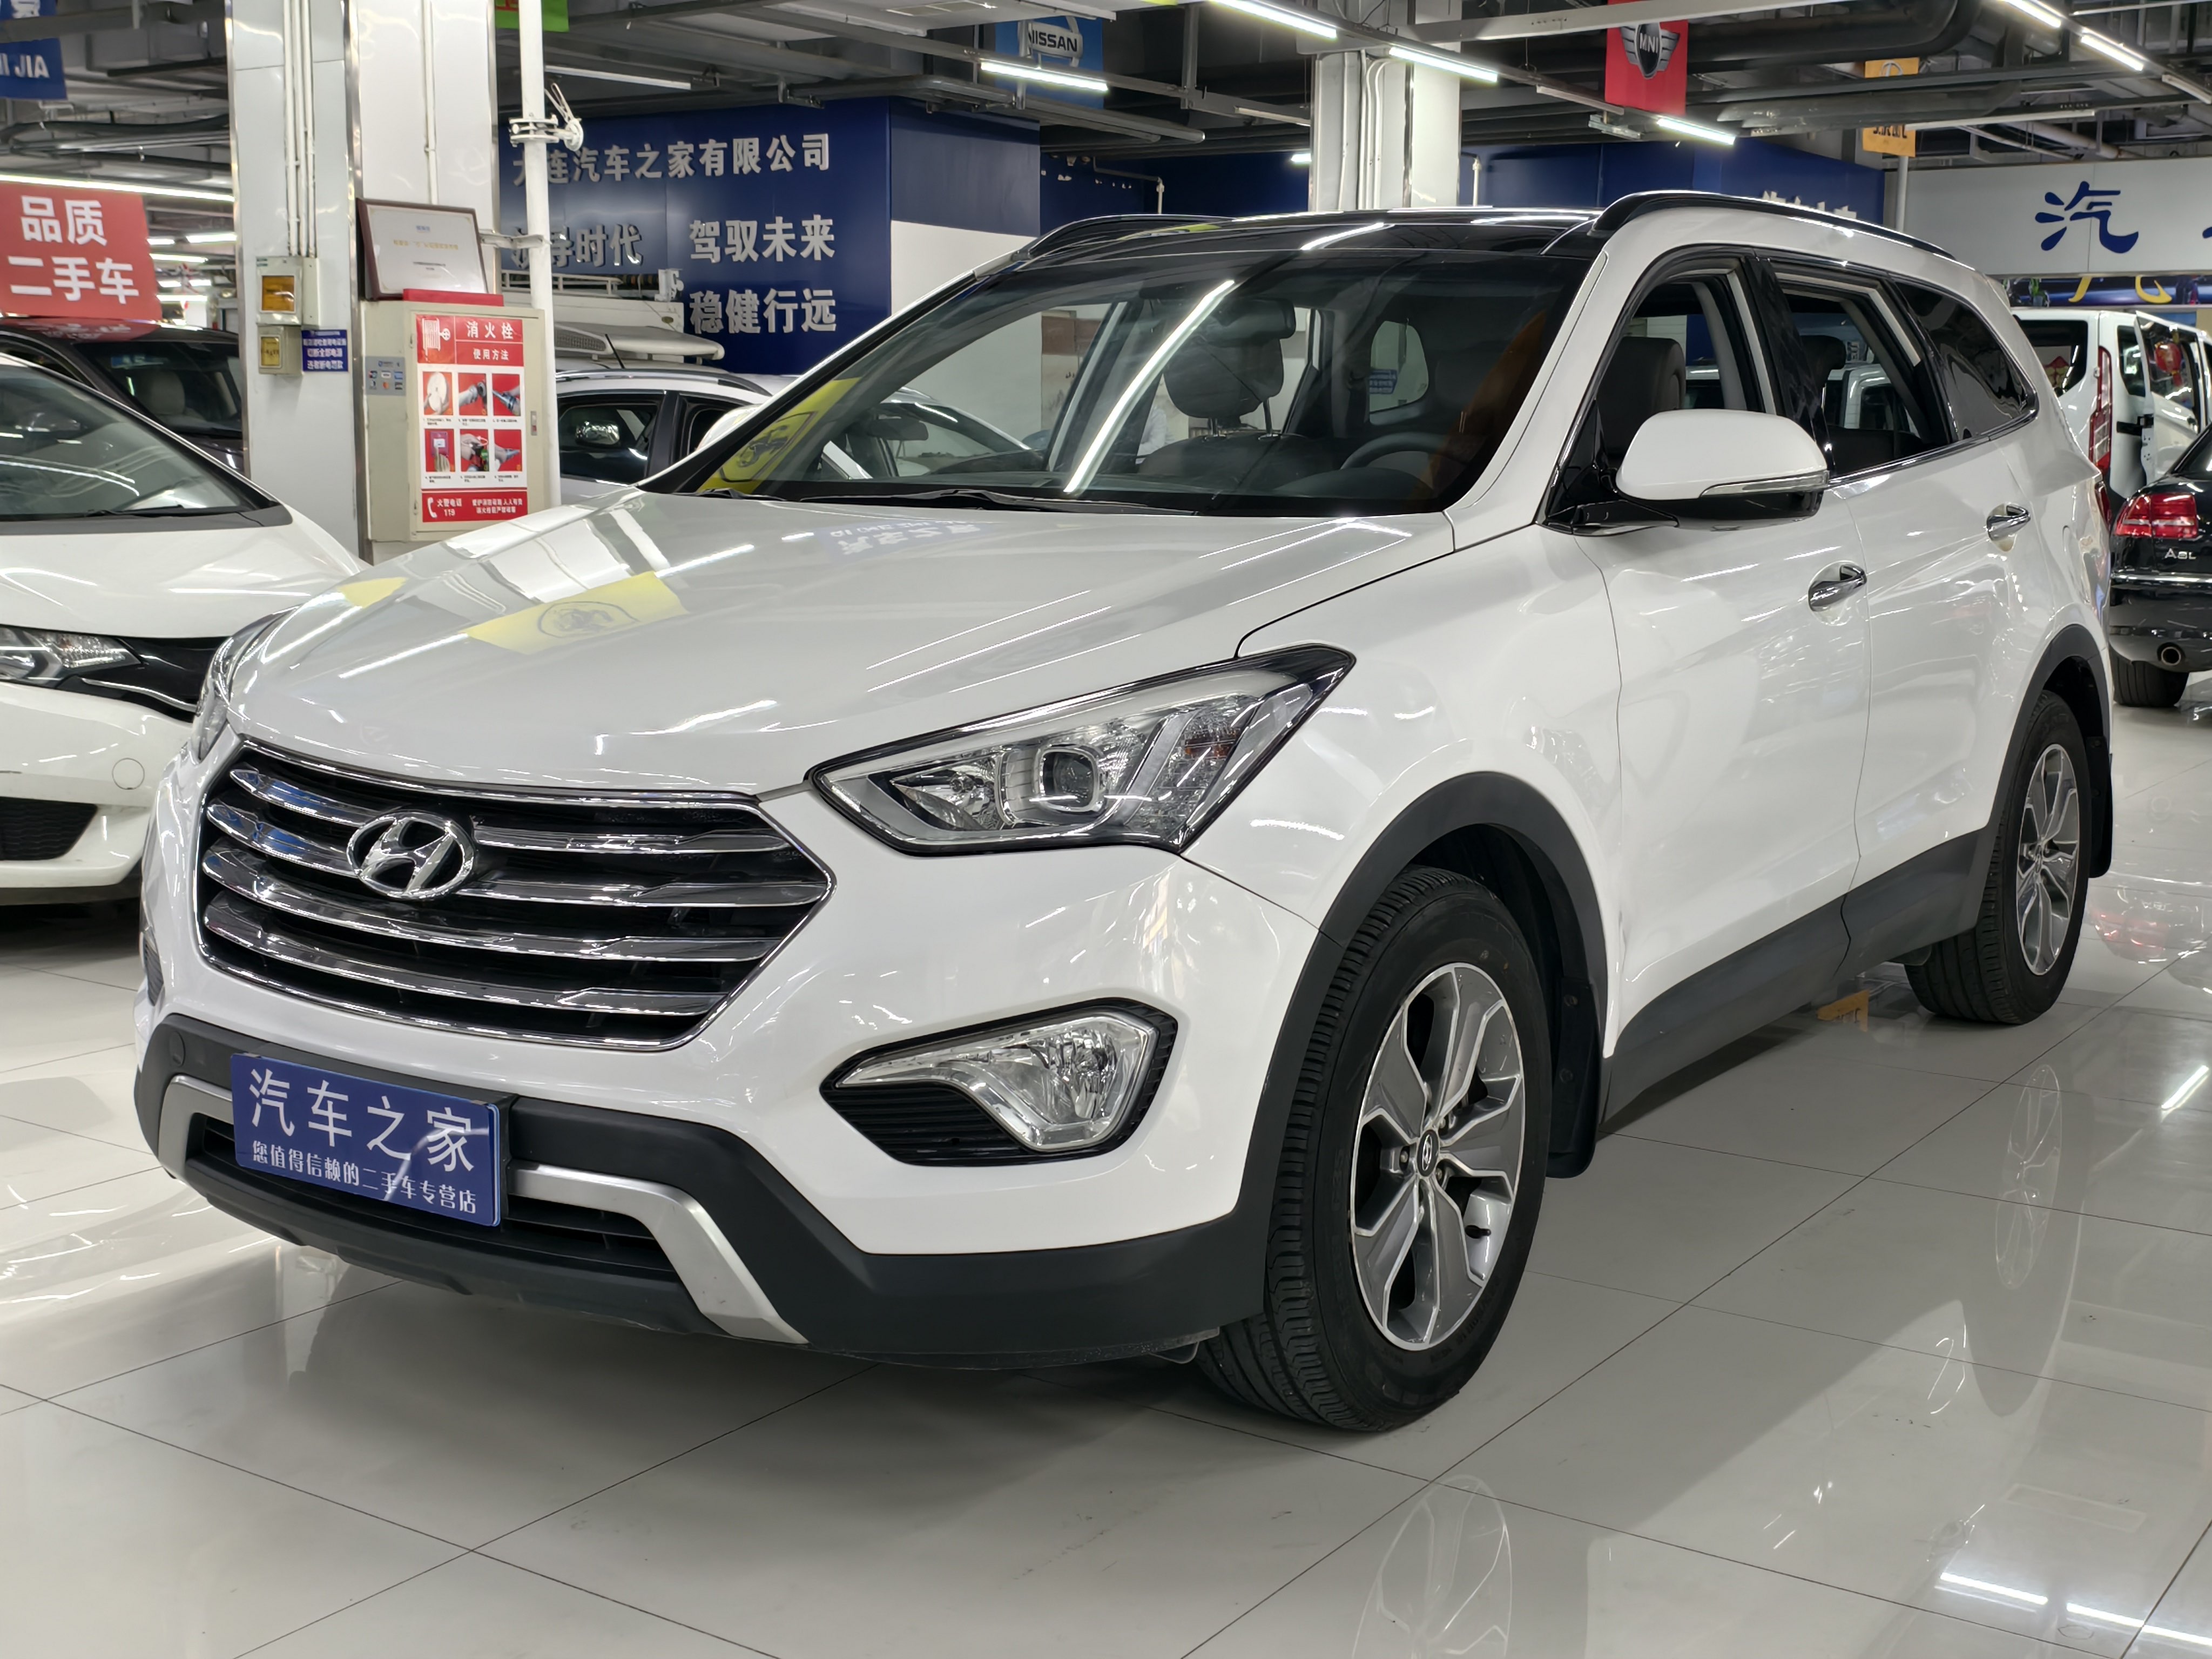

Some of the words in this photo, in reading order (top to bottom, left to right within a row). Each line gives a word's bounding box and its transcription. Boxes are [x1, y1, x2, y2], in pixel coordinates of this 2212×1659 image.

[1028, 29, 1077, 52] NISSAN
[15, 55, 50, 78] JIA
[21, 195, 107, 247] 品质
[690, 214, 835, 264] 驾驭未来
[8, 256, 140, 305] 二手车
[466, 321, 514, 340] 消火栓
[689, 288, 837, 334] 稳健行远
[473, 348, 509, 361] 使用方法
[249, 1068, 474, 1172] 汽车之家
[252, 1140, 477, 1215] 您值得信赖的二手车专营店
